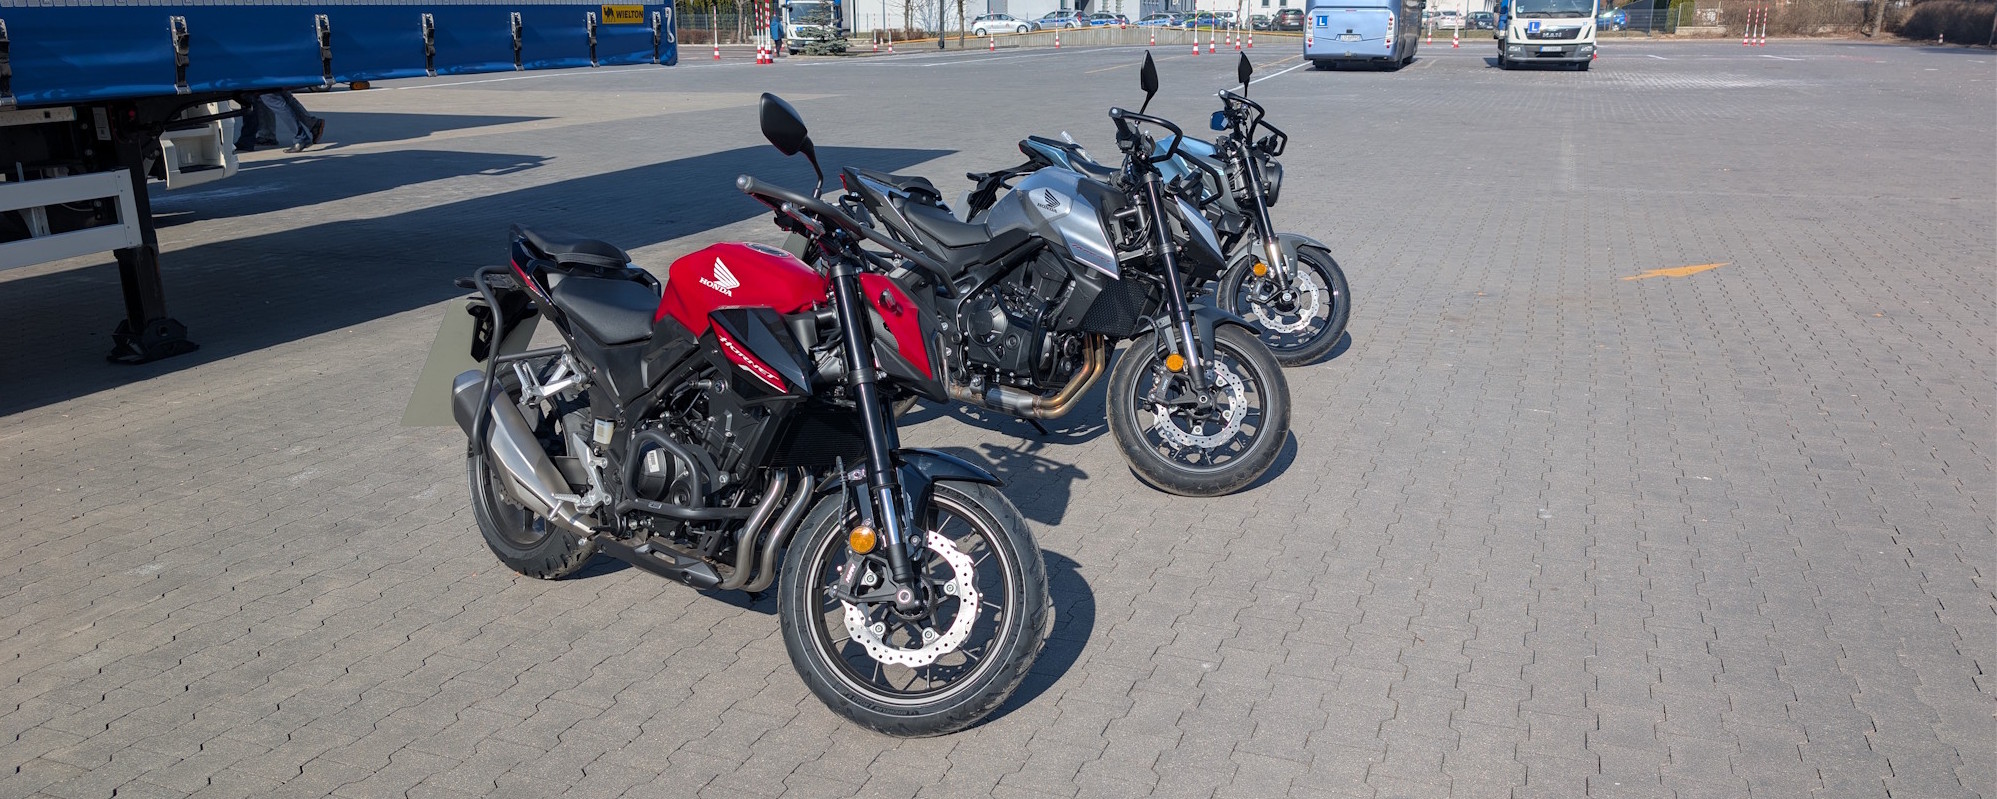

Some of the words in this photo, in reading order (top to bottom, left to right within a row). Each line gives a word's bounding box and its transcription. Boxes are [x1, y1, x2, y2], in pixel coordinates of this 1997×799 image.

[616, 10, 644, 19] WIELTON
[1319, 16, 1326, 26] L
[1531, 22, 1538, 31] L
[1037, 202, 1058, 213] HONDA
[699, 276, 732, 297] HONDA
[719, 335, 779, 380] HORNET
